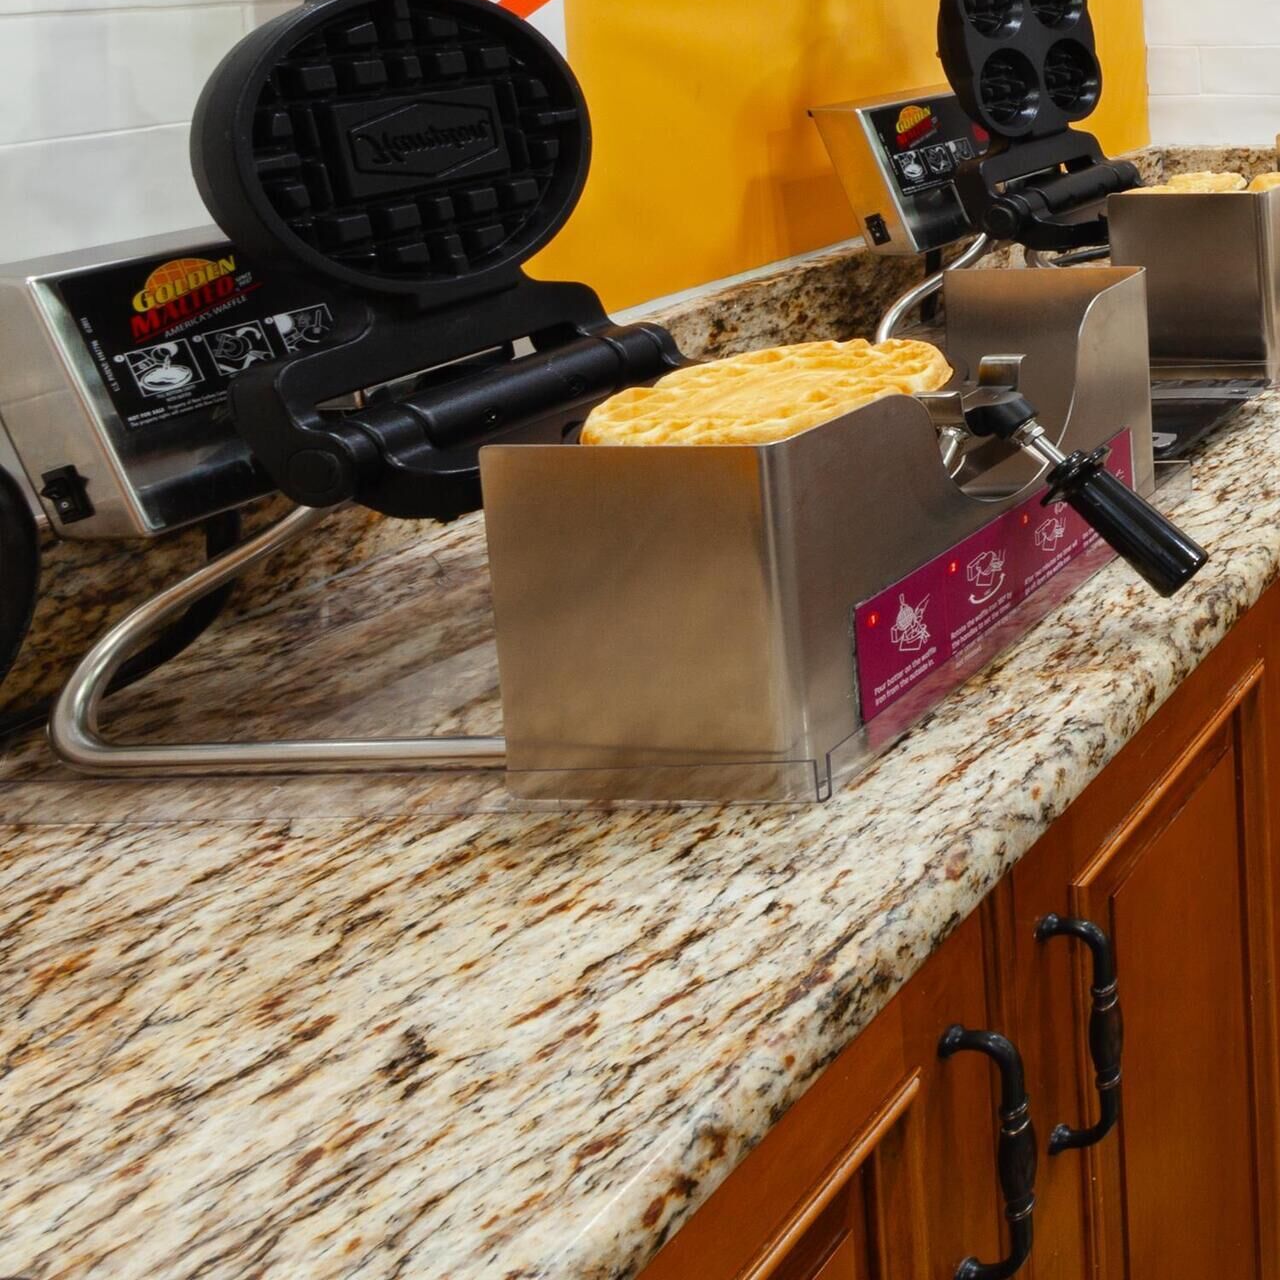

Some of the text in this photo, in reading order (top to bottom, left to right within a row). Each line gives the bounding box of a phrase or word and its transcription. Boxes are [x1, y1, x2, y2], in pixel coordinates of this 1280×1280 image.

[132, 255, 236, 312] GOLDEN
[130, 275, 234, 338] MALTED
[164, 295, 248, 338] AMERICA'S WAFFLE
[874, 682, 887, 696] Pour
[912, 658, 921, 668] the
[887, 684, 900, 697] from
[900, 678, 909, 688] the
